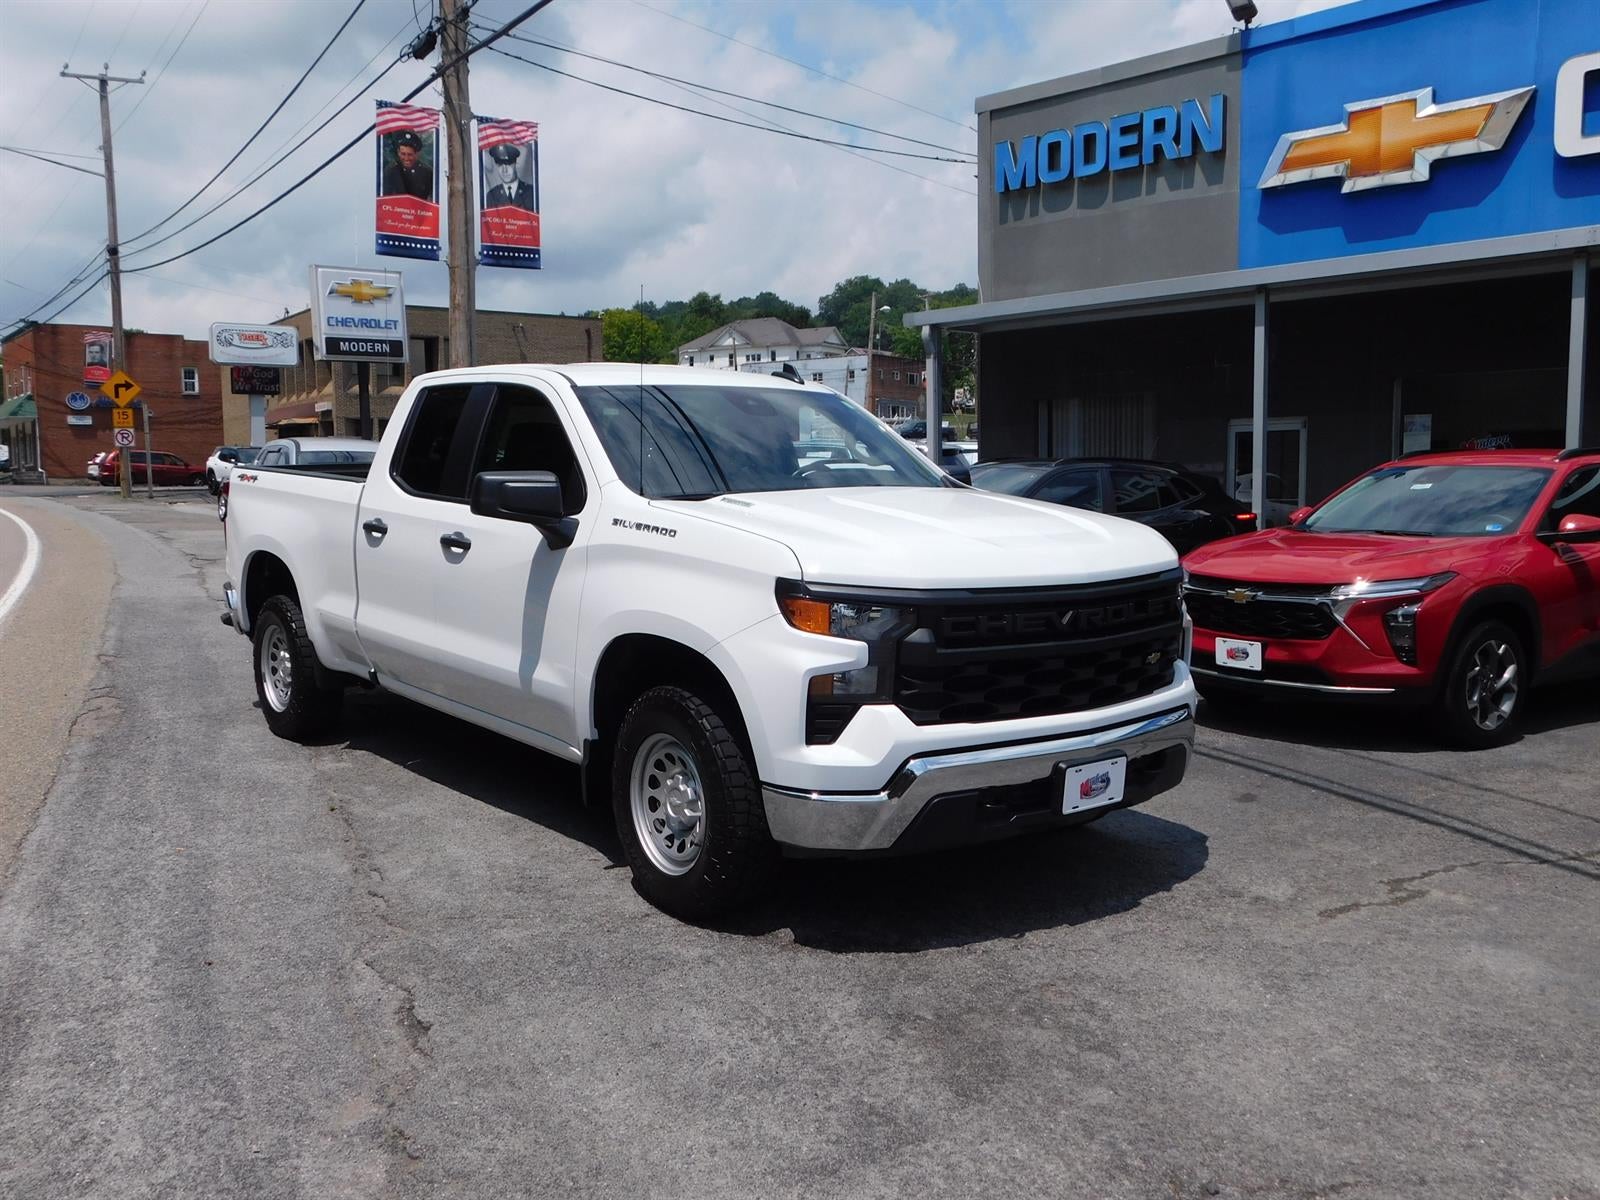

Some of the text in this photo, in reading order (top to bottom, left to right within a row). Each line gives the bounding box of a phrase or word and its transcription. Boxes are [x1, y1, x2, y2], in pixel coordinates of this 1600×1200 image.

[994, 92, 1227, 193] MODERN
[326, 316, 399, 330] CHEVROLET
[340, 341, 390, 353] MODERN
[253, 368, 273, 378] God
[235, 382, 280, 392] We Trust
[117, 410, 129, 420] 15
[611, 518, 678, 538] SILVERADO
